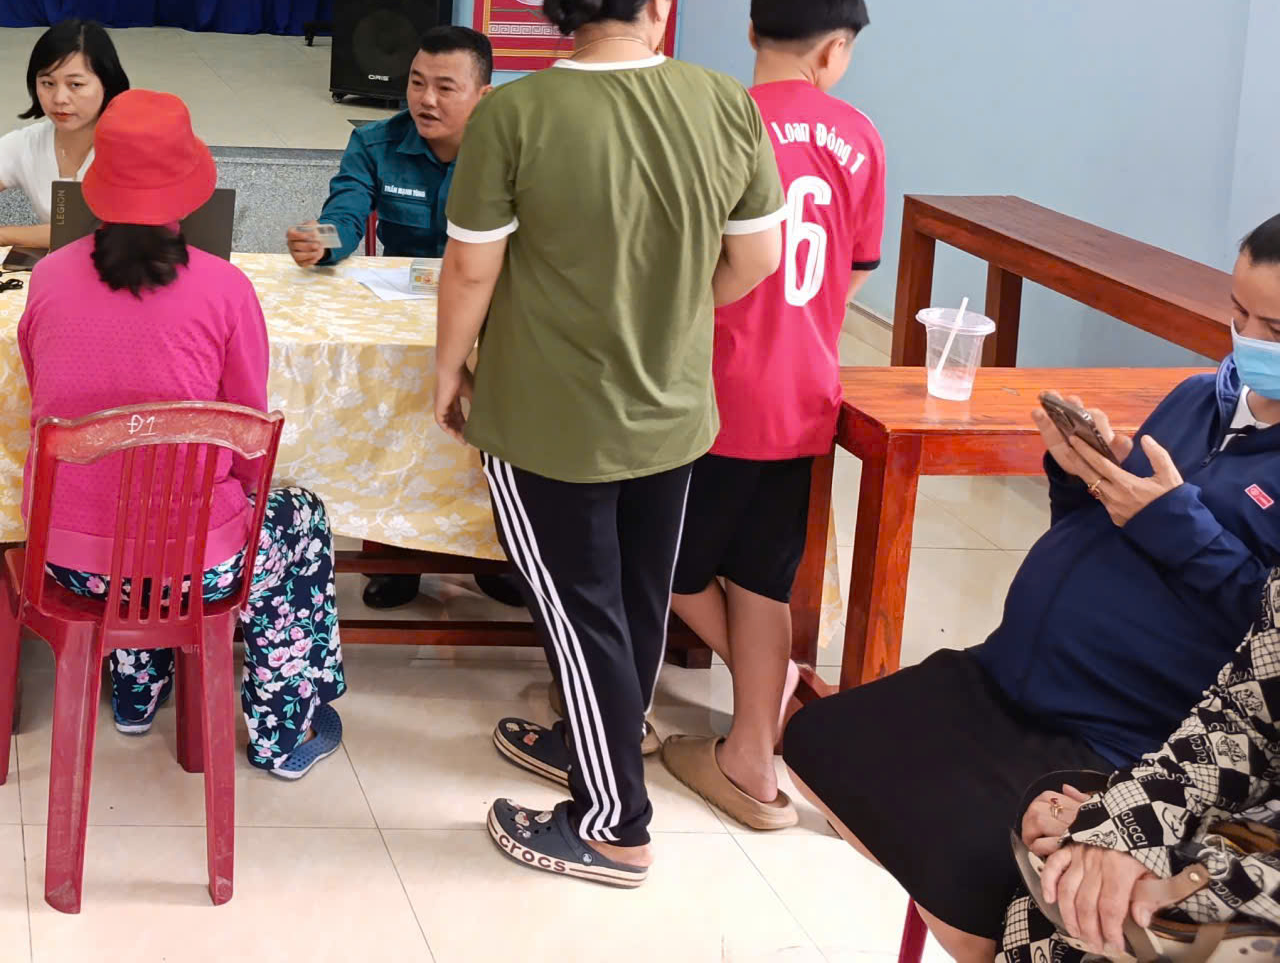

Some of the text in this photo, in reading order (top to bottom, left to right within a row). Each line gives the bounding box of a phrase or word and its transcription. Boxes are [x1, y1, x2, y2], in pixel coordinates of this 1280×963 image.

[771, 121, 865, 175] Loan Đông 1
[56, 189, 65, 225] LEGION
[784, 175, 832, 307] 6
[1120, 809, 1149, 847] GUCCI
[497, 833, 568, 874] crocs
